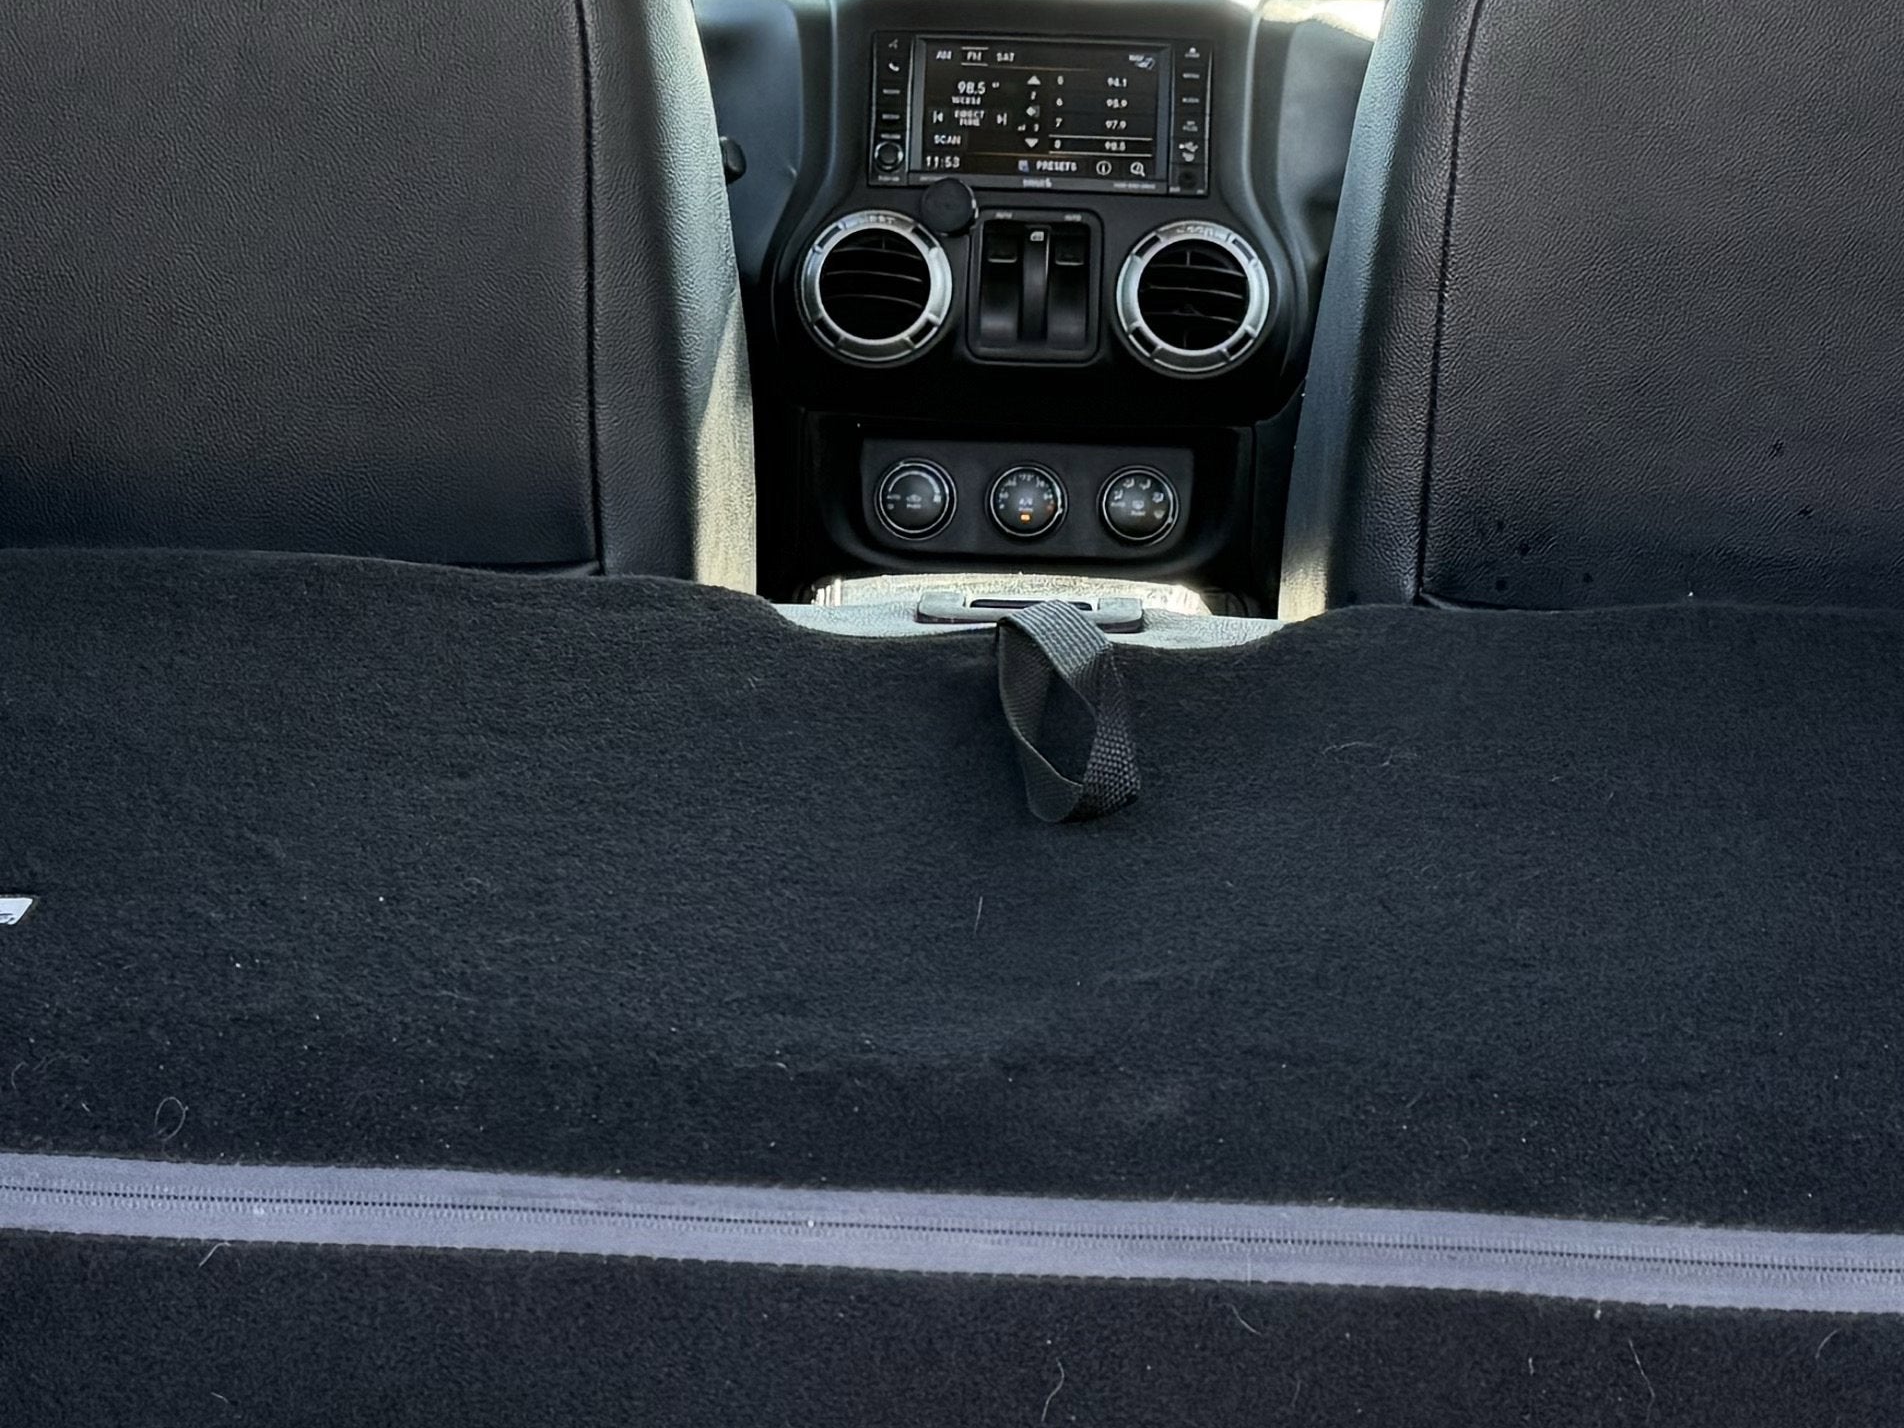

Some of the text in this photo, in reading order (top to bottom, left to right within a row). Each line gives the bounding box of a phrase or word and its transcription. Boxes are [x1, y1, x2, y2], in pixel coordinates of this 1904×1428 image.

[957, 80, 986, 94] 98.5
[934, 134, 962, 145] SCAN
[1036, 159, 1078, 172] PRESETS
